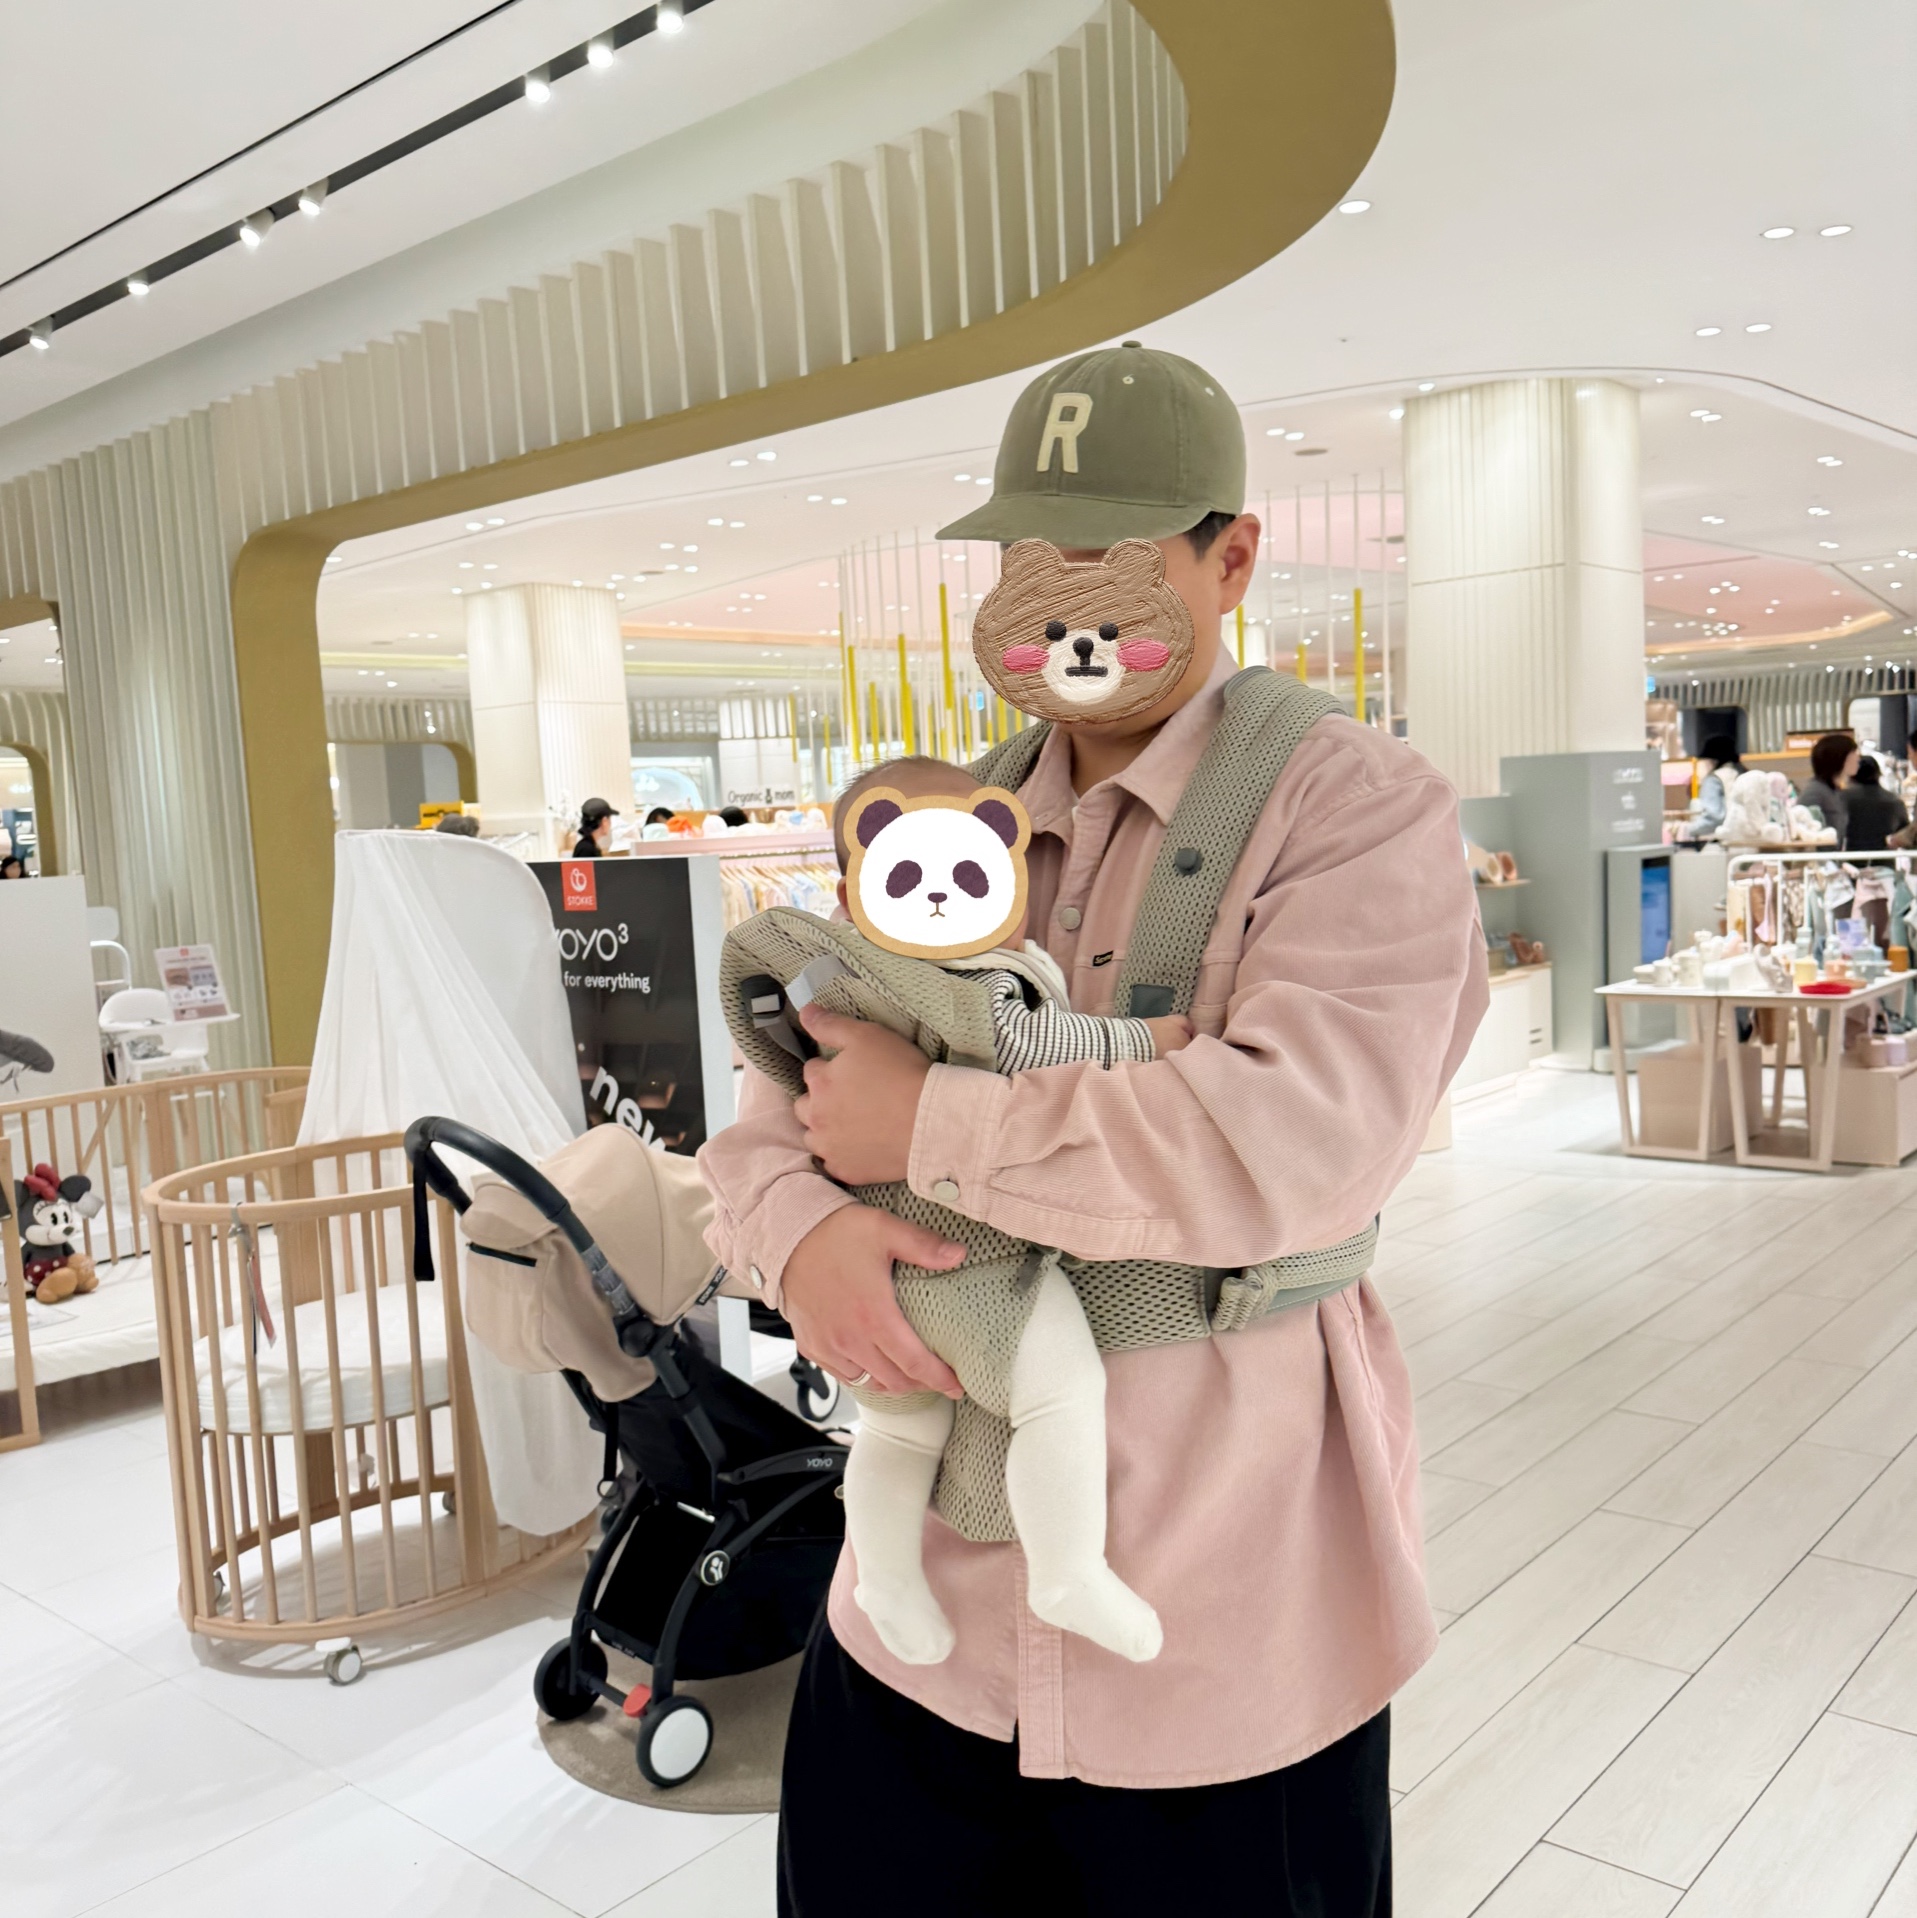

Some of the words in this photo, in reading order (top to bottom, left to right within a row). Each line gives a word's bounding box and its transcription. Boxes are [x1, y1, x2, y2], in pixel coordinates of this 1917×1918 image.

[1036, 392, 1093, 474] R
[728, 790, 763, 806] Organic
[775, 790, 795, 801] mom
[567, 896, 594, 906] STOKKE
[564, 971, 582, 987] for
[584, 972, 651, 994] everything
[807, 1457, 833, 1468] YOYO
